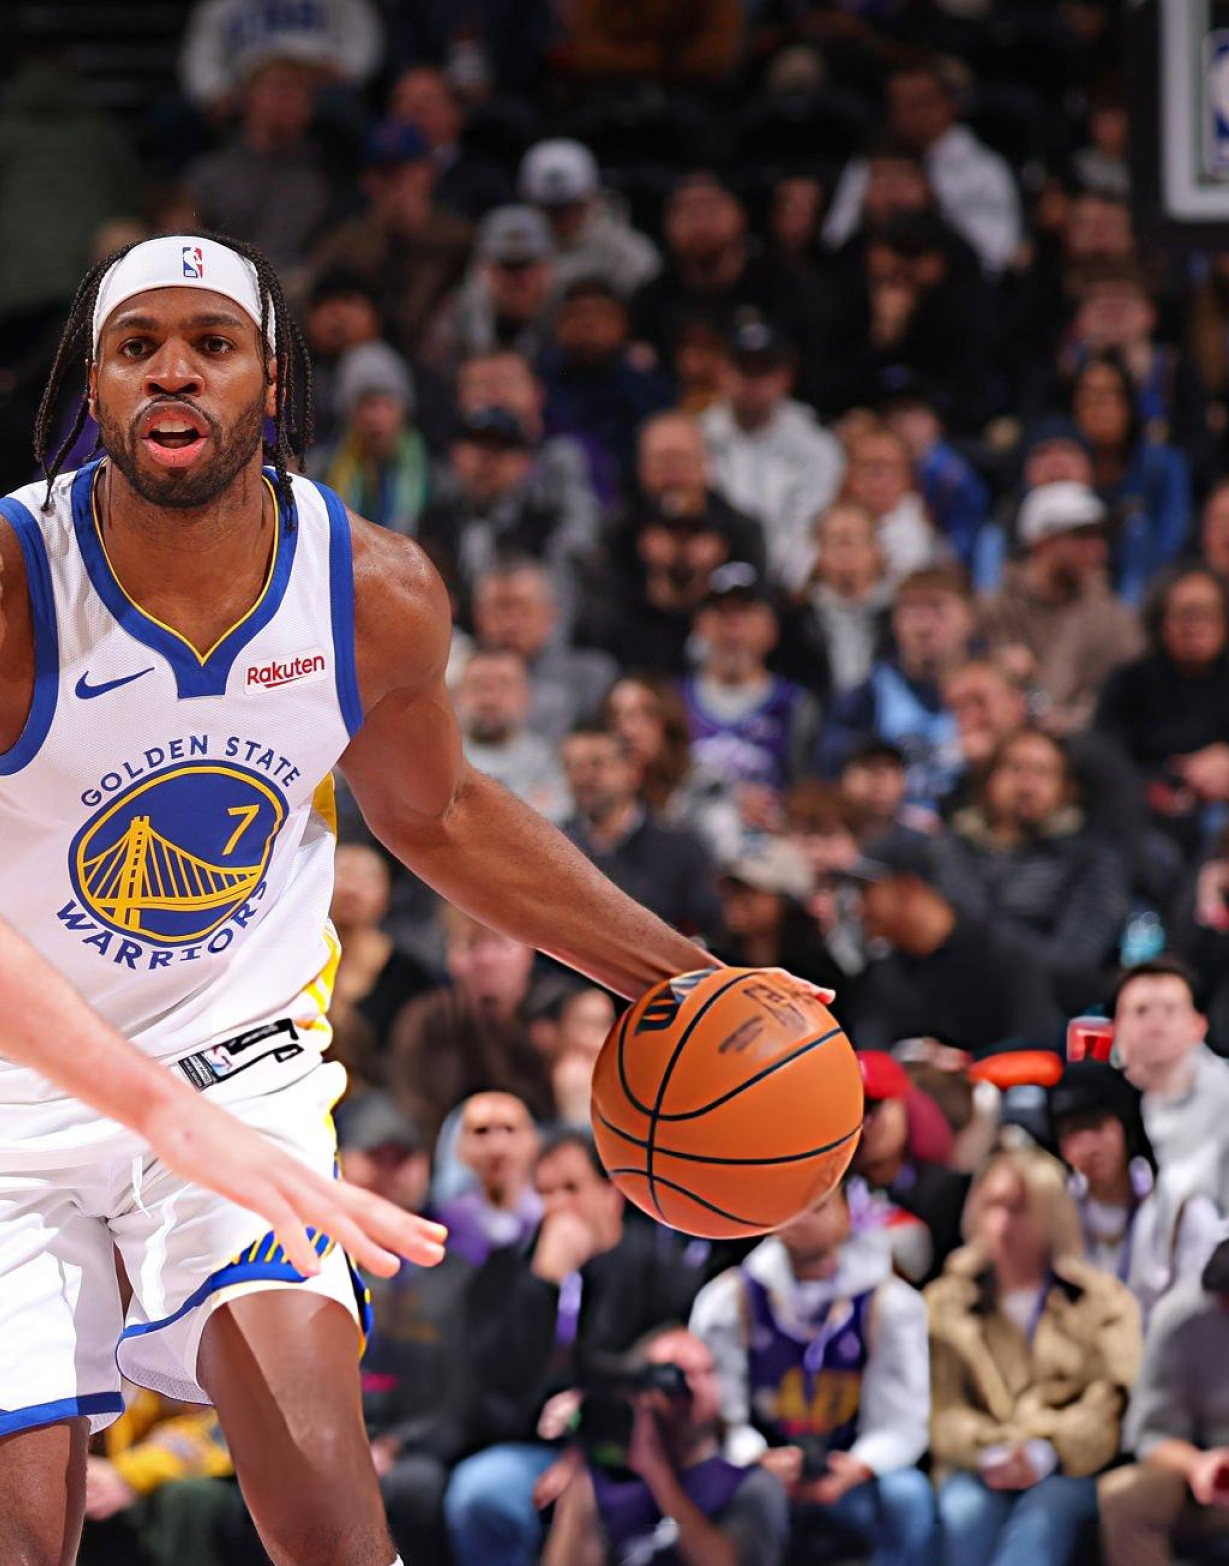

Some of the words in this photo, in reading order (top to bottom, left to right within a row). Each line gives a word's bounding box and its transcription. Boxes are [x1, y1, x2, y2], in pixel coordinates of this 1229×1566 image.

[247, 655, 325, 686] Rakuten
[81, 735, 208, 807] GOLDEN
[225, 736, 301, 787] STATE
[222, 803, 260, 856] 7
[56, 880, 268, 970] WARRIORS
